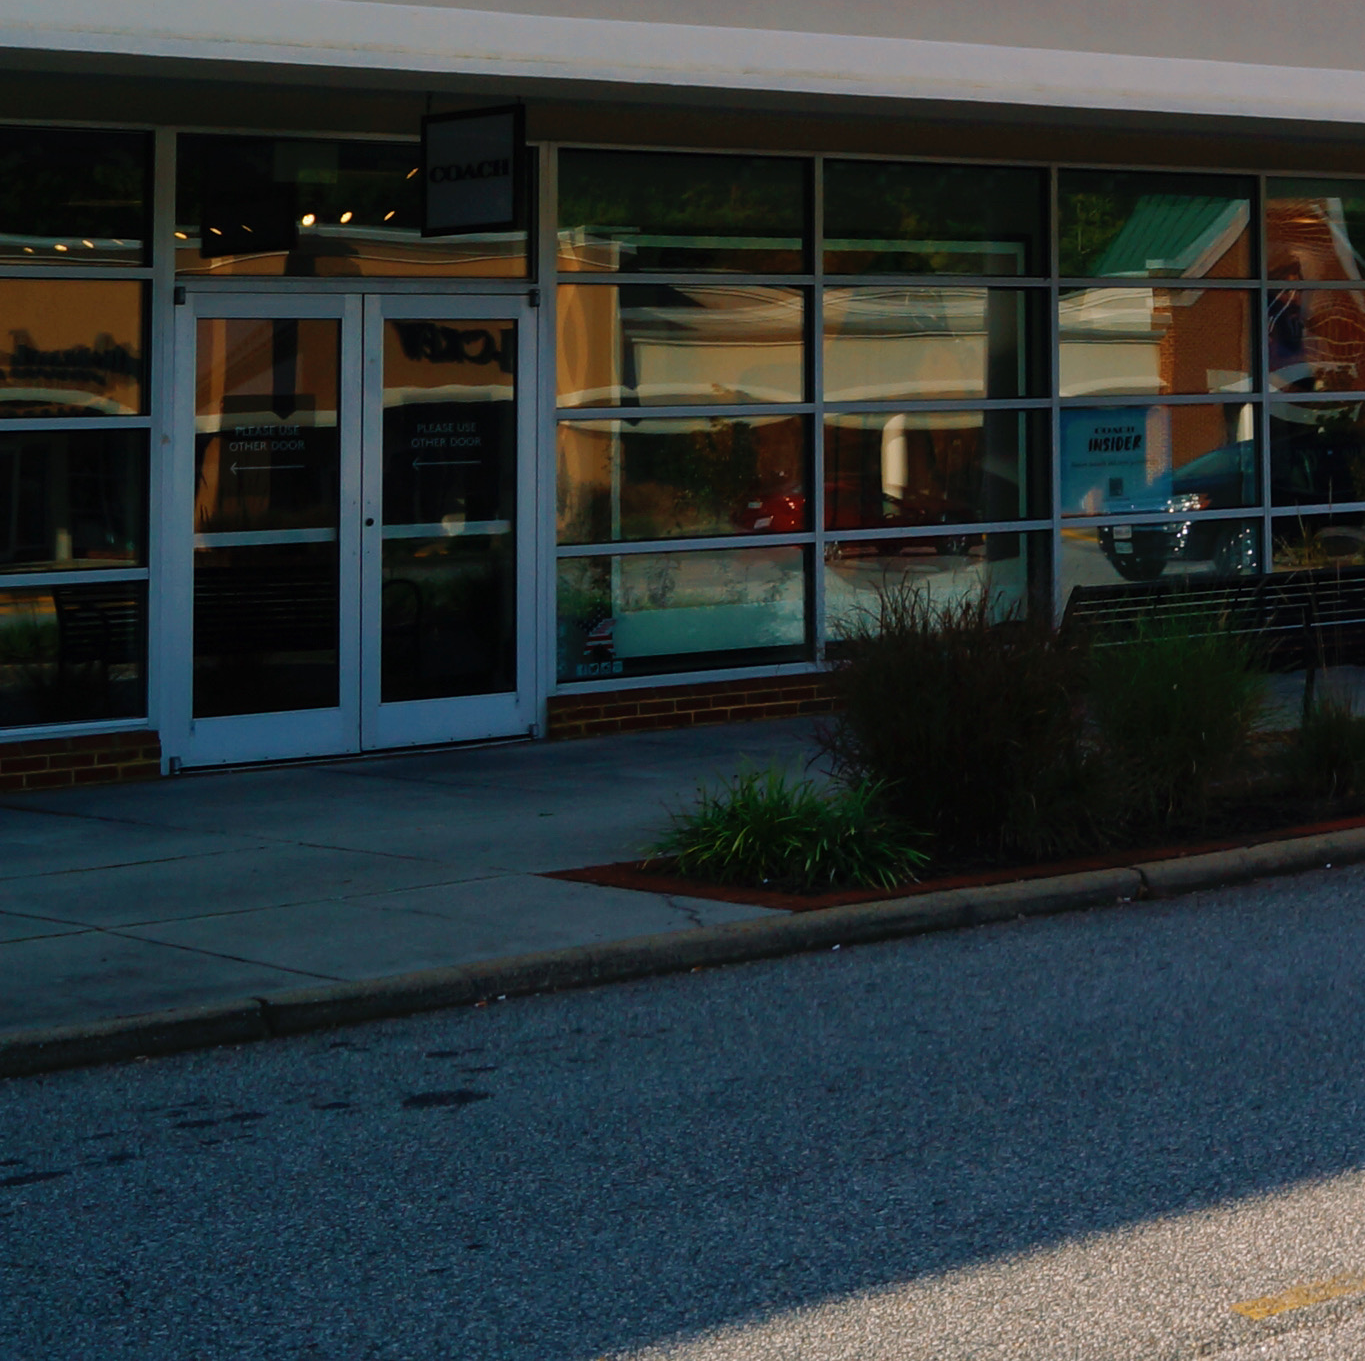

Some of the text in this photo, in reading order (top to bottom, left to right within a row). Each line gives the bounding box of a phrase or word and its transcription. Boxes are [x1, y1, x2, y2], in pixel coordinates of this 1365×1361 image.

[429, 158, 509, 183] COACH
[235, 425, 300, 437] PLEASE USE
[417, 422, 477, 433] PLEASE USE
[229, 440, 305, 452] OTHER DOOR
[411, 437, 481, 447] OTHER DOOR
[1089, 435, 1142, 452] INSIDER
